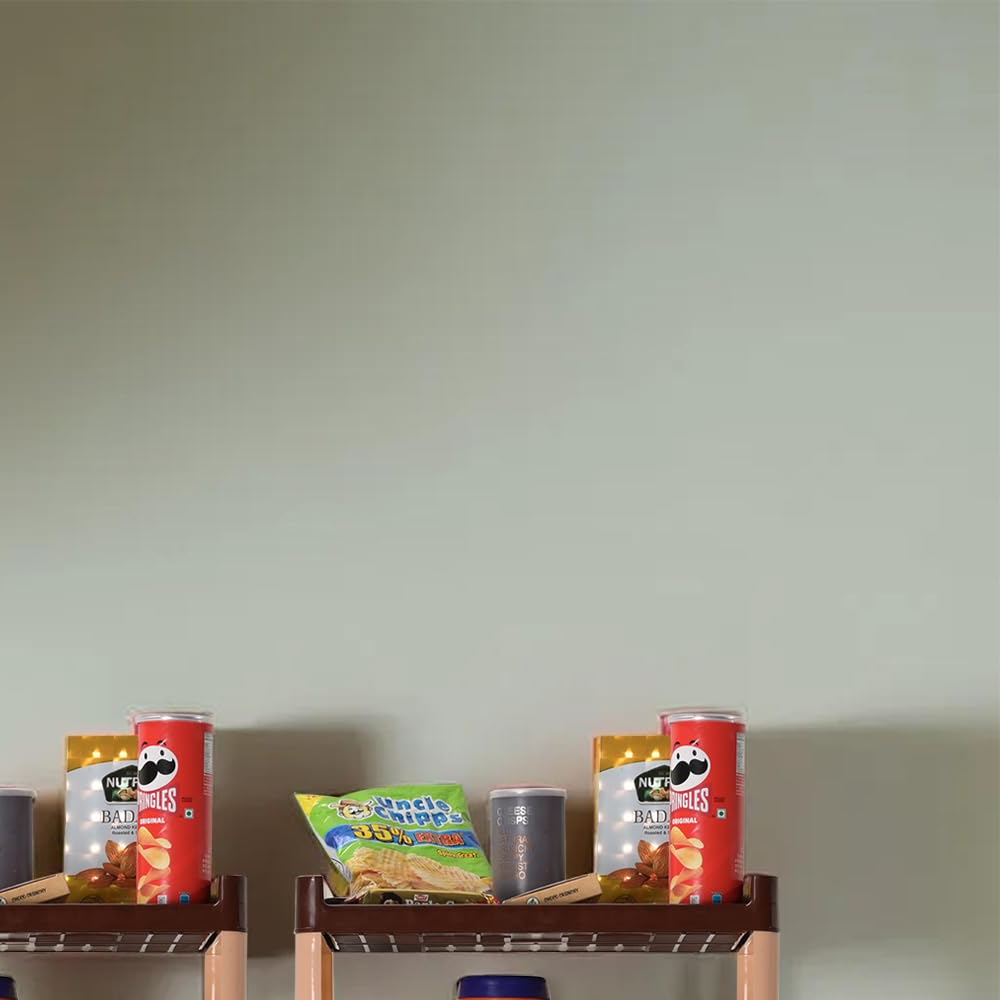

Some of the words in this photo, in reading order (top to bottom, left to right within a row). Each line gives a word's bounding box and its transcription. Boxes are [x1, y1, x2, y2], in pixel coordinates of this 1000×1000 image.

[137, 787, 177, 812] RINGLES
[373, 795, 451, 812] Uncle
[669, 787, 709, 812] RINGLES
[102, 810, 138, 823] BAD
[373, 805, 463, 827] Chipps
[634, 810, 670, 823] BAD
[351, 824, 413, 846] 35%
[415, 832, 465, 846] EXTRA
